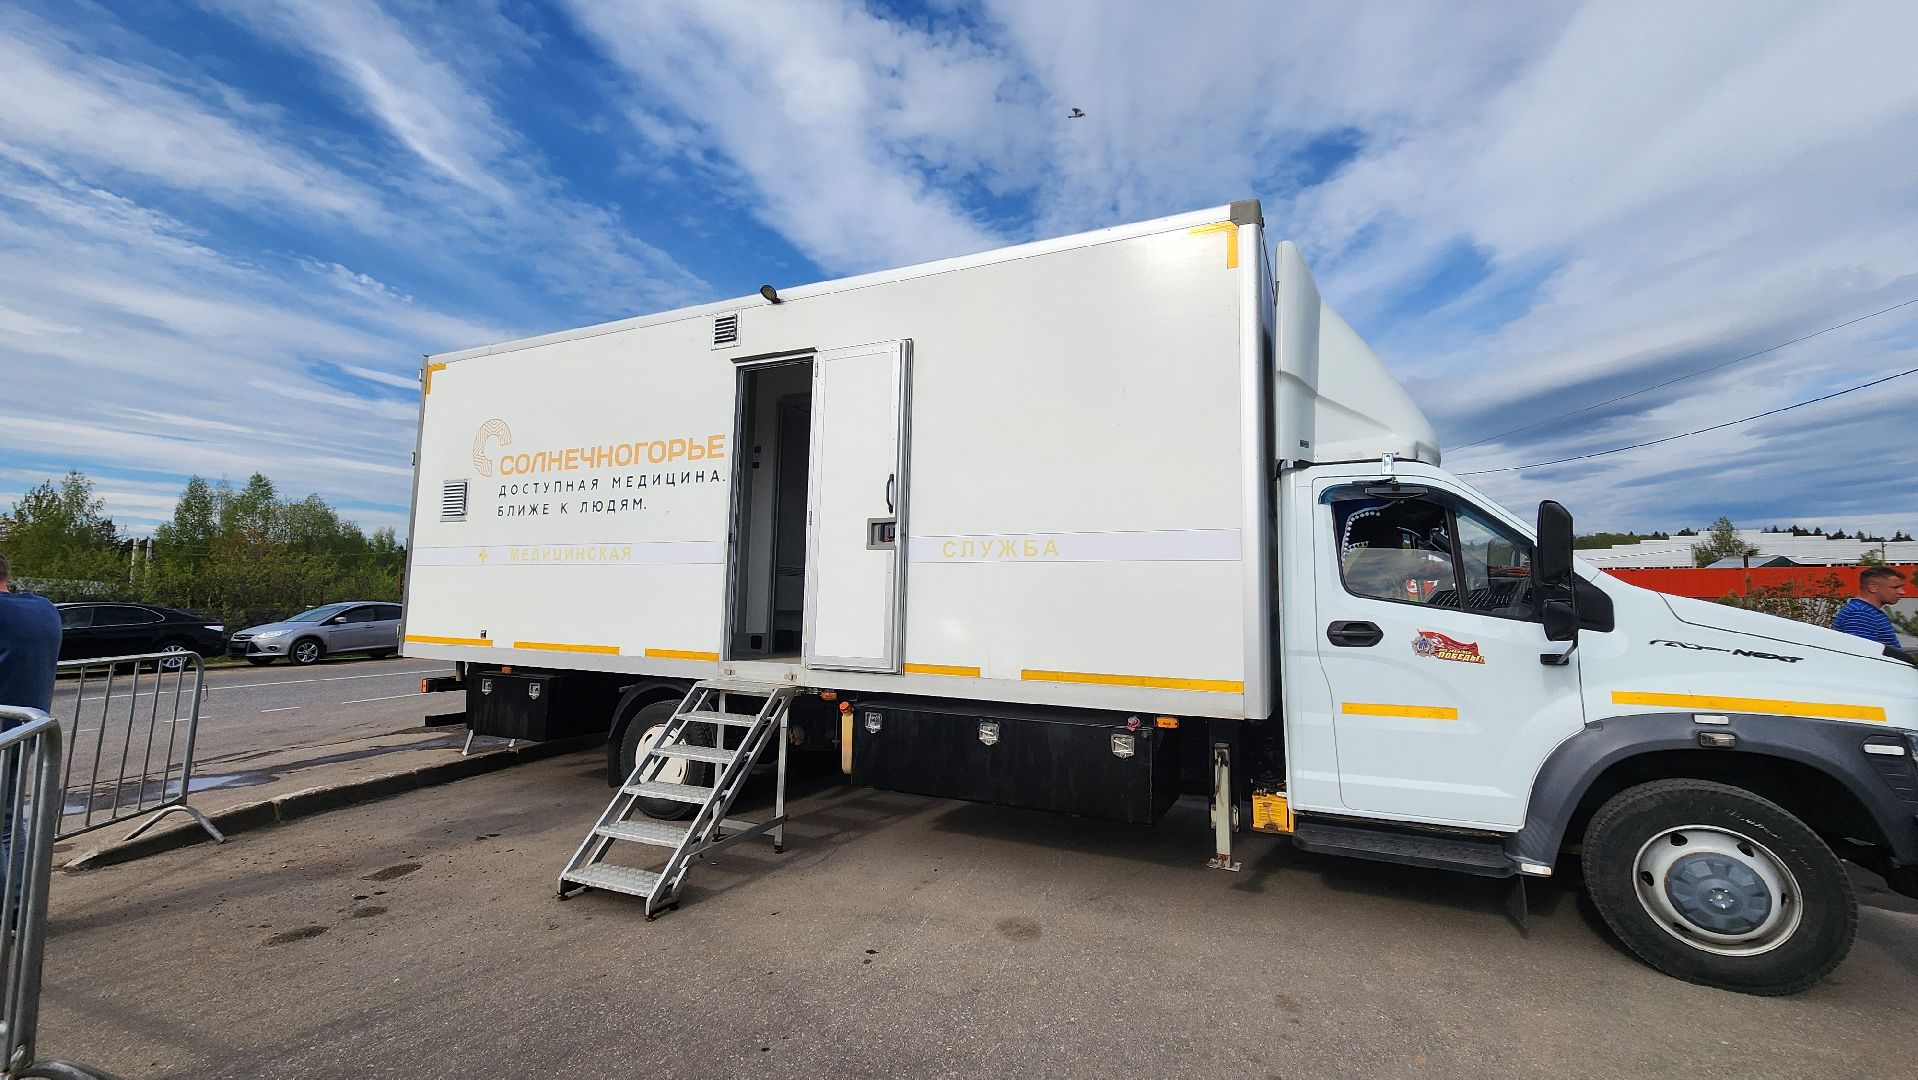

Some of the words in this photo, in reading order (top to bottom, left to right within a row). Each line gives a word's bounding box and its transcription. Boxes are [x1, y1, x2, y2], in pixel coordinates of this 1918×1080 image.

[499, 434, 726, 475] СОЛНЕЧНОГОРЬЕ
[498, 478, 600, 498] ДОСТУПНАЯ
[611, 469, 727, 489] МЕДИЦИНА.
[497, 503, 550, 517] БЛИЖЕ
[560, 502, 569, 514] К
[579, 498, 648, 514] ЛЮДЯМ.
[509, 547, 633, 561] МЕДИЦИНСКАЯ
[942, 540, 1060, 558] СЛУЖБА
